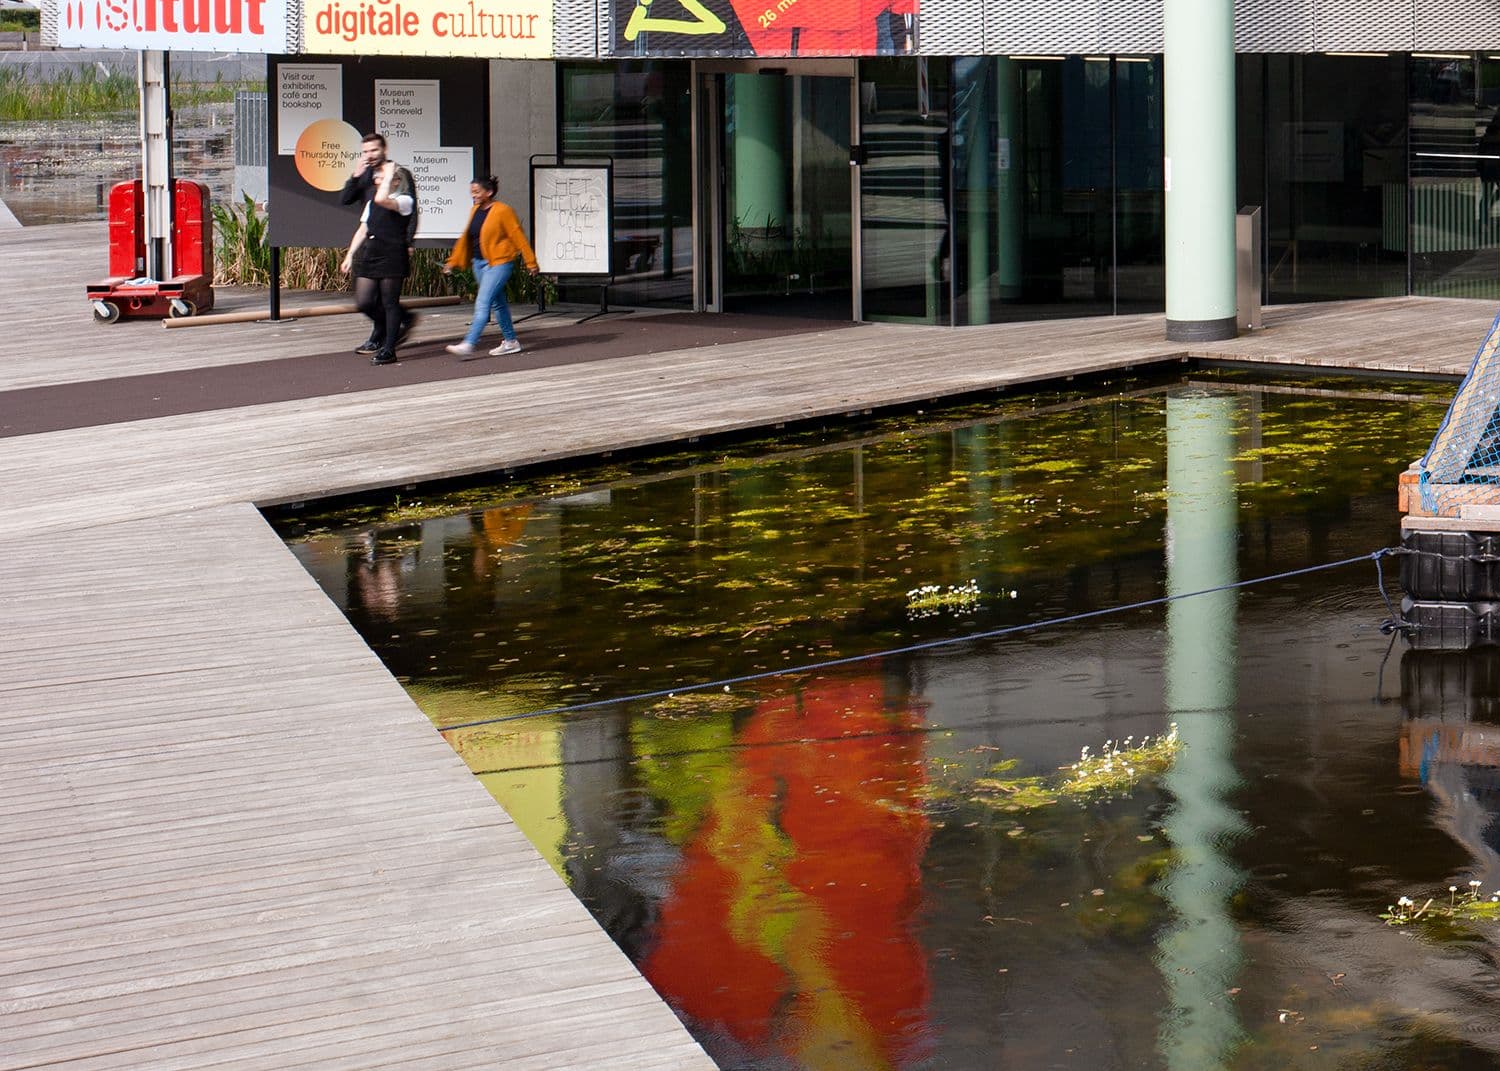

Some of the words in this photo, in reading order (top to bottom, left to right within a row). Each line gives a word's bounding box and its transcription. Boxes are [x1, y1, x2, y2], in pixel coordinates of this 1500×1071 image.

[316, 2, 420, 42] digitale
[432, 0, 539, 38] cultuur
[758, 9, 778, 28] 26
[282, 72, 300, 81] Visit
[282, 81, 327, 90] exhibitions,
[282, 91, 300, 99] café
[302, 91, 317, 99] and
[282, 101, 322, 109] bookshop
[380, 106, 423, 115] Sonneveld
[321, 141, 341, 149] Free
[300, 150, 339, 160] Thursday
[413, 156, 448, 164] Museum
[413, 165, 429, 173] and
[413, 174, 456, 182] Sonneveld
